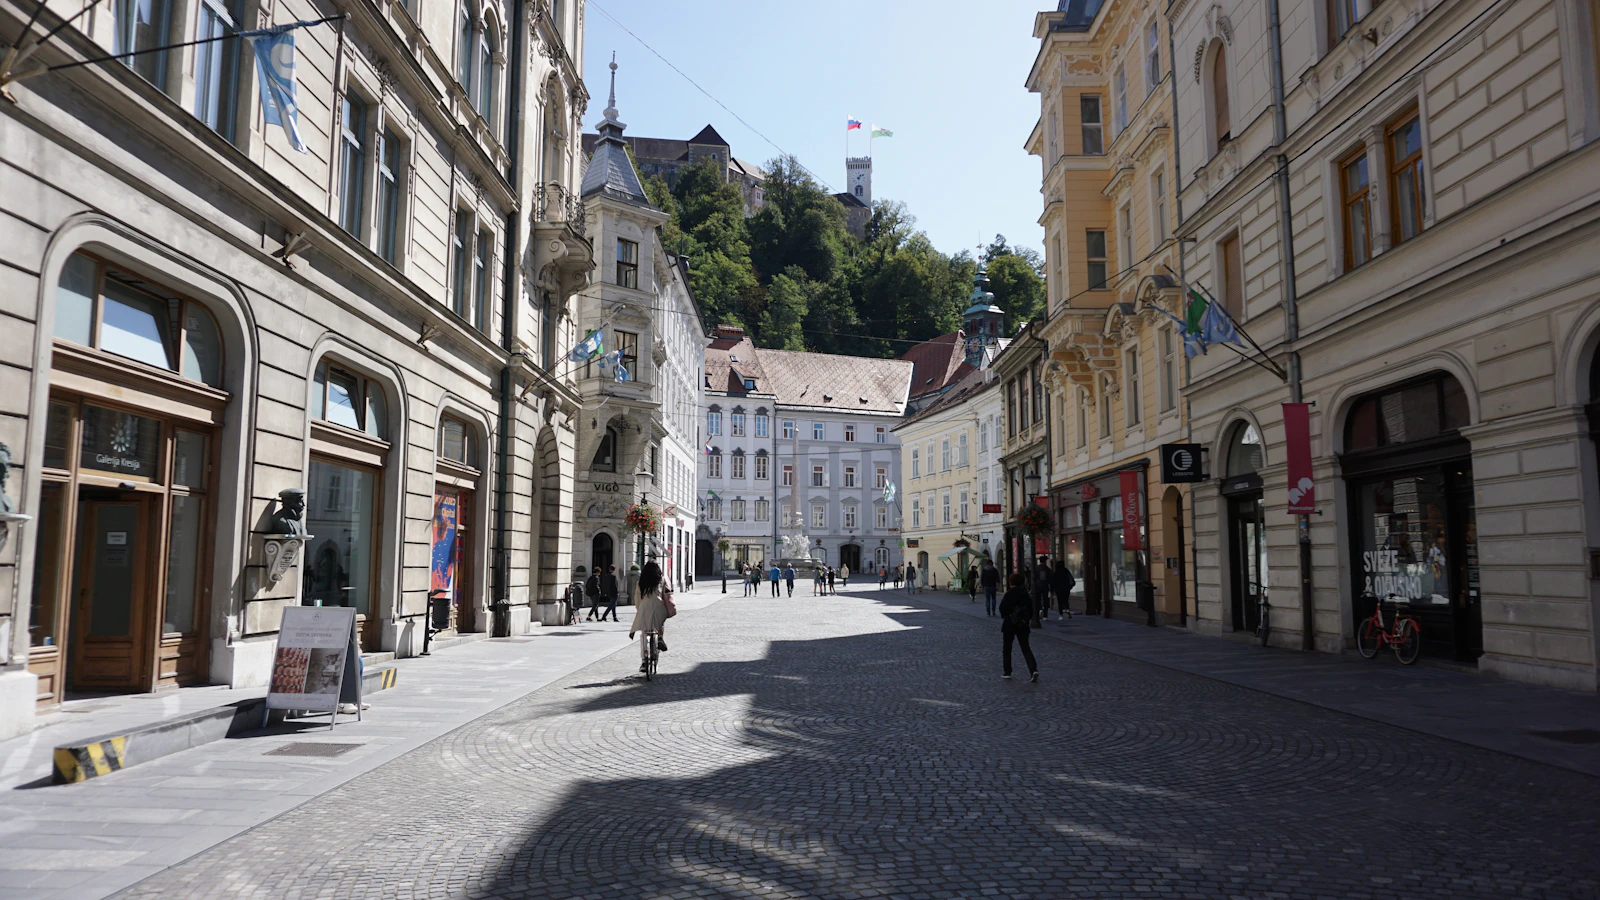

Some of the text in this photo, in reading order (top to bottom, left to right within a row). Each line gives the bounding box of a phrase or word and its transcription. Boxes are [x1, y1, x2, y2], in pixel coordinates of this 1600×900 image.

[96, 453, 140, 470] Galerija Kresija
[1125, 491, 1138, 531] s.Oliver
[1363, 544, 1399, 573] SVEŽE
